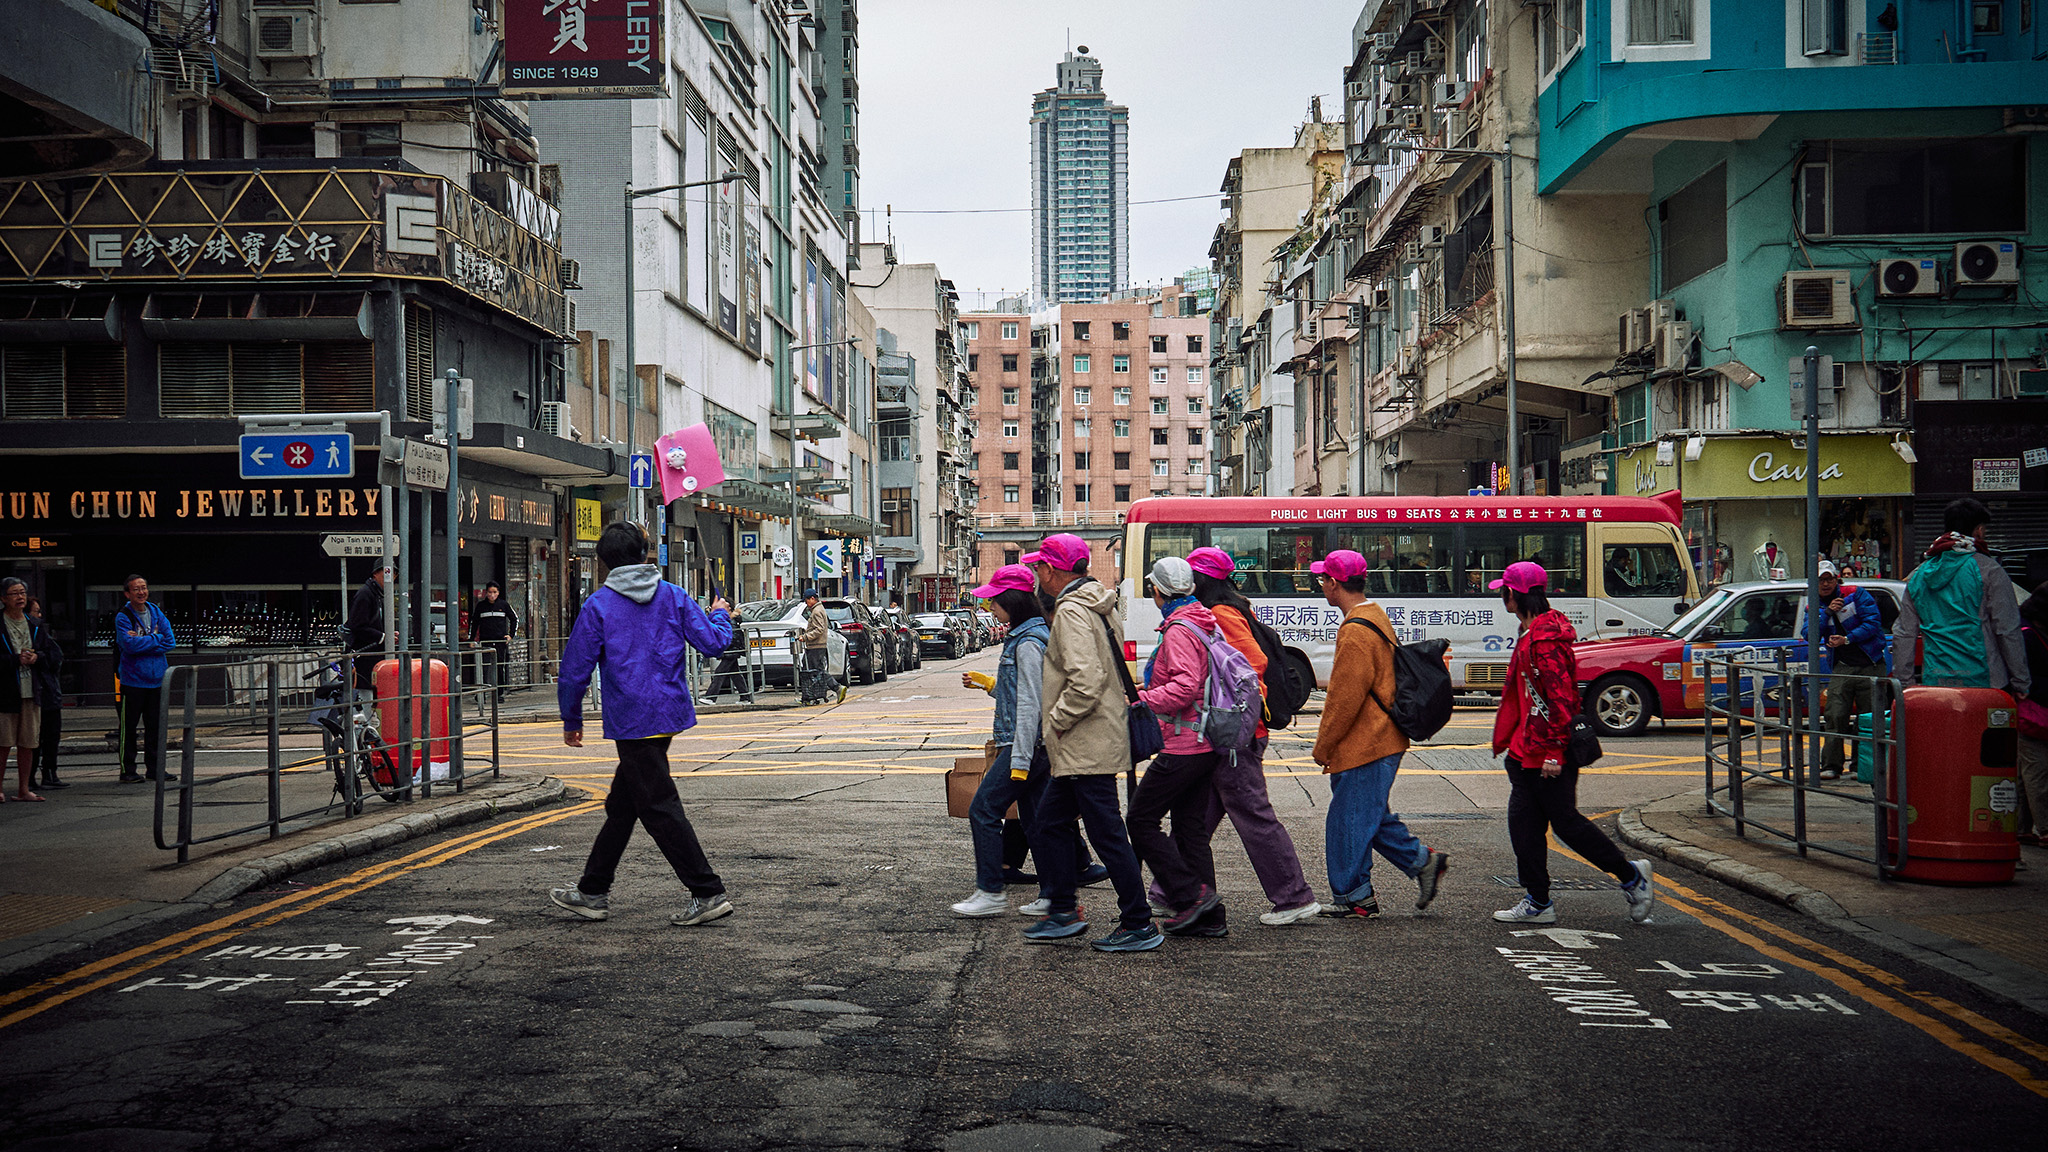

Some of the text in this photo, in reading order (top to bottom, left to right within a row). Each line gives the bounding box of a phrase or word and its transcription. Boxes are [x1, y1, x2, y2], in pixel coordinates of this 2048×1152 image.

[512, 66, 599, 80] SINCE 1949
[131, 231, 337, 268] 珍珍珠寶金行
[1748, 452, 1844, 482] Cava
[70, 491, 157, 519] CHUN
[176, 489, 380, 518] JEWELLERY
[1270, 508, 1603, 519] PUBLIC LIGHT BUS 19 SEATS 公共小型巴士十九座位
[331, 536, 345, 545] Nga
[347, 536, 361, 544] Tsin
[362, 536, 376, 544] Wai
[744, 536, 754, 547] P
[1254, 605, 1319, 626] 糖尿病
[1323, 610, 1340, 626] 及
[1410, 609, 1495, 626] 篩查和治理
[1392, 627, 1427, 642] 計劃
[1495, 946, 1618, 984] RIGHT
[1541, 985, 1673, 1030] LOOK
